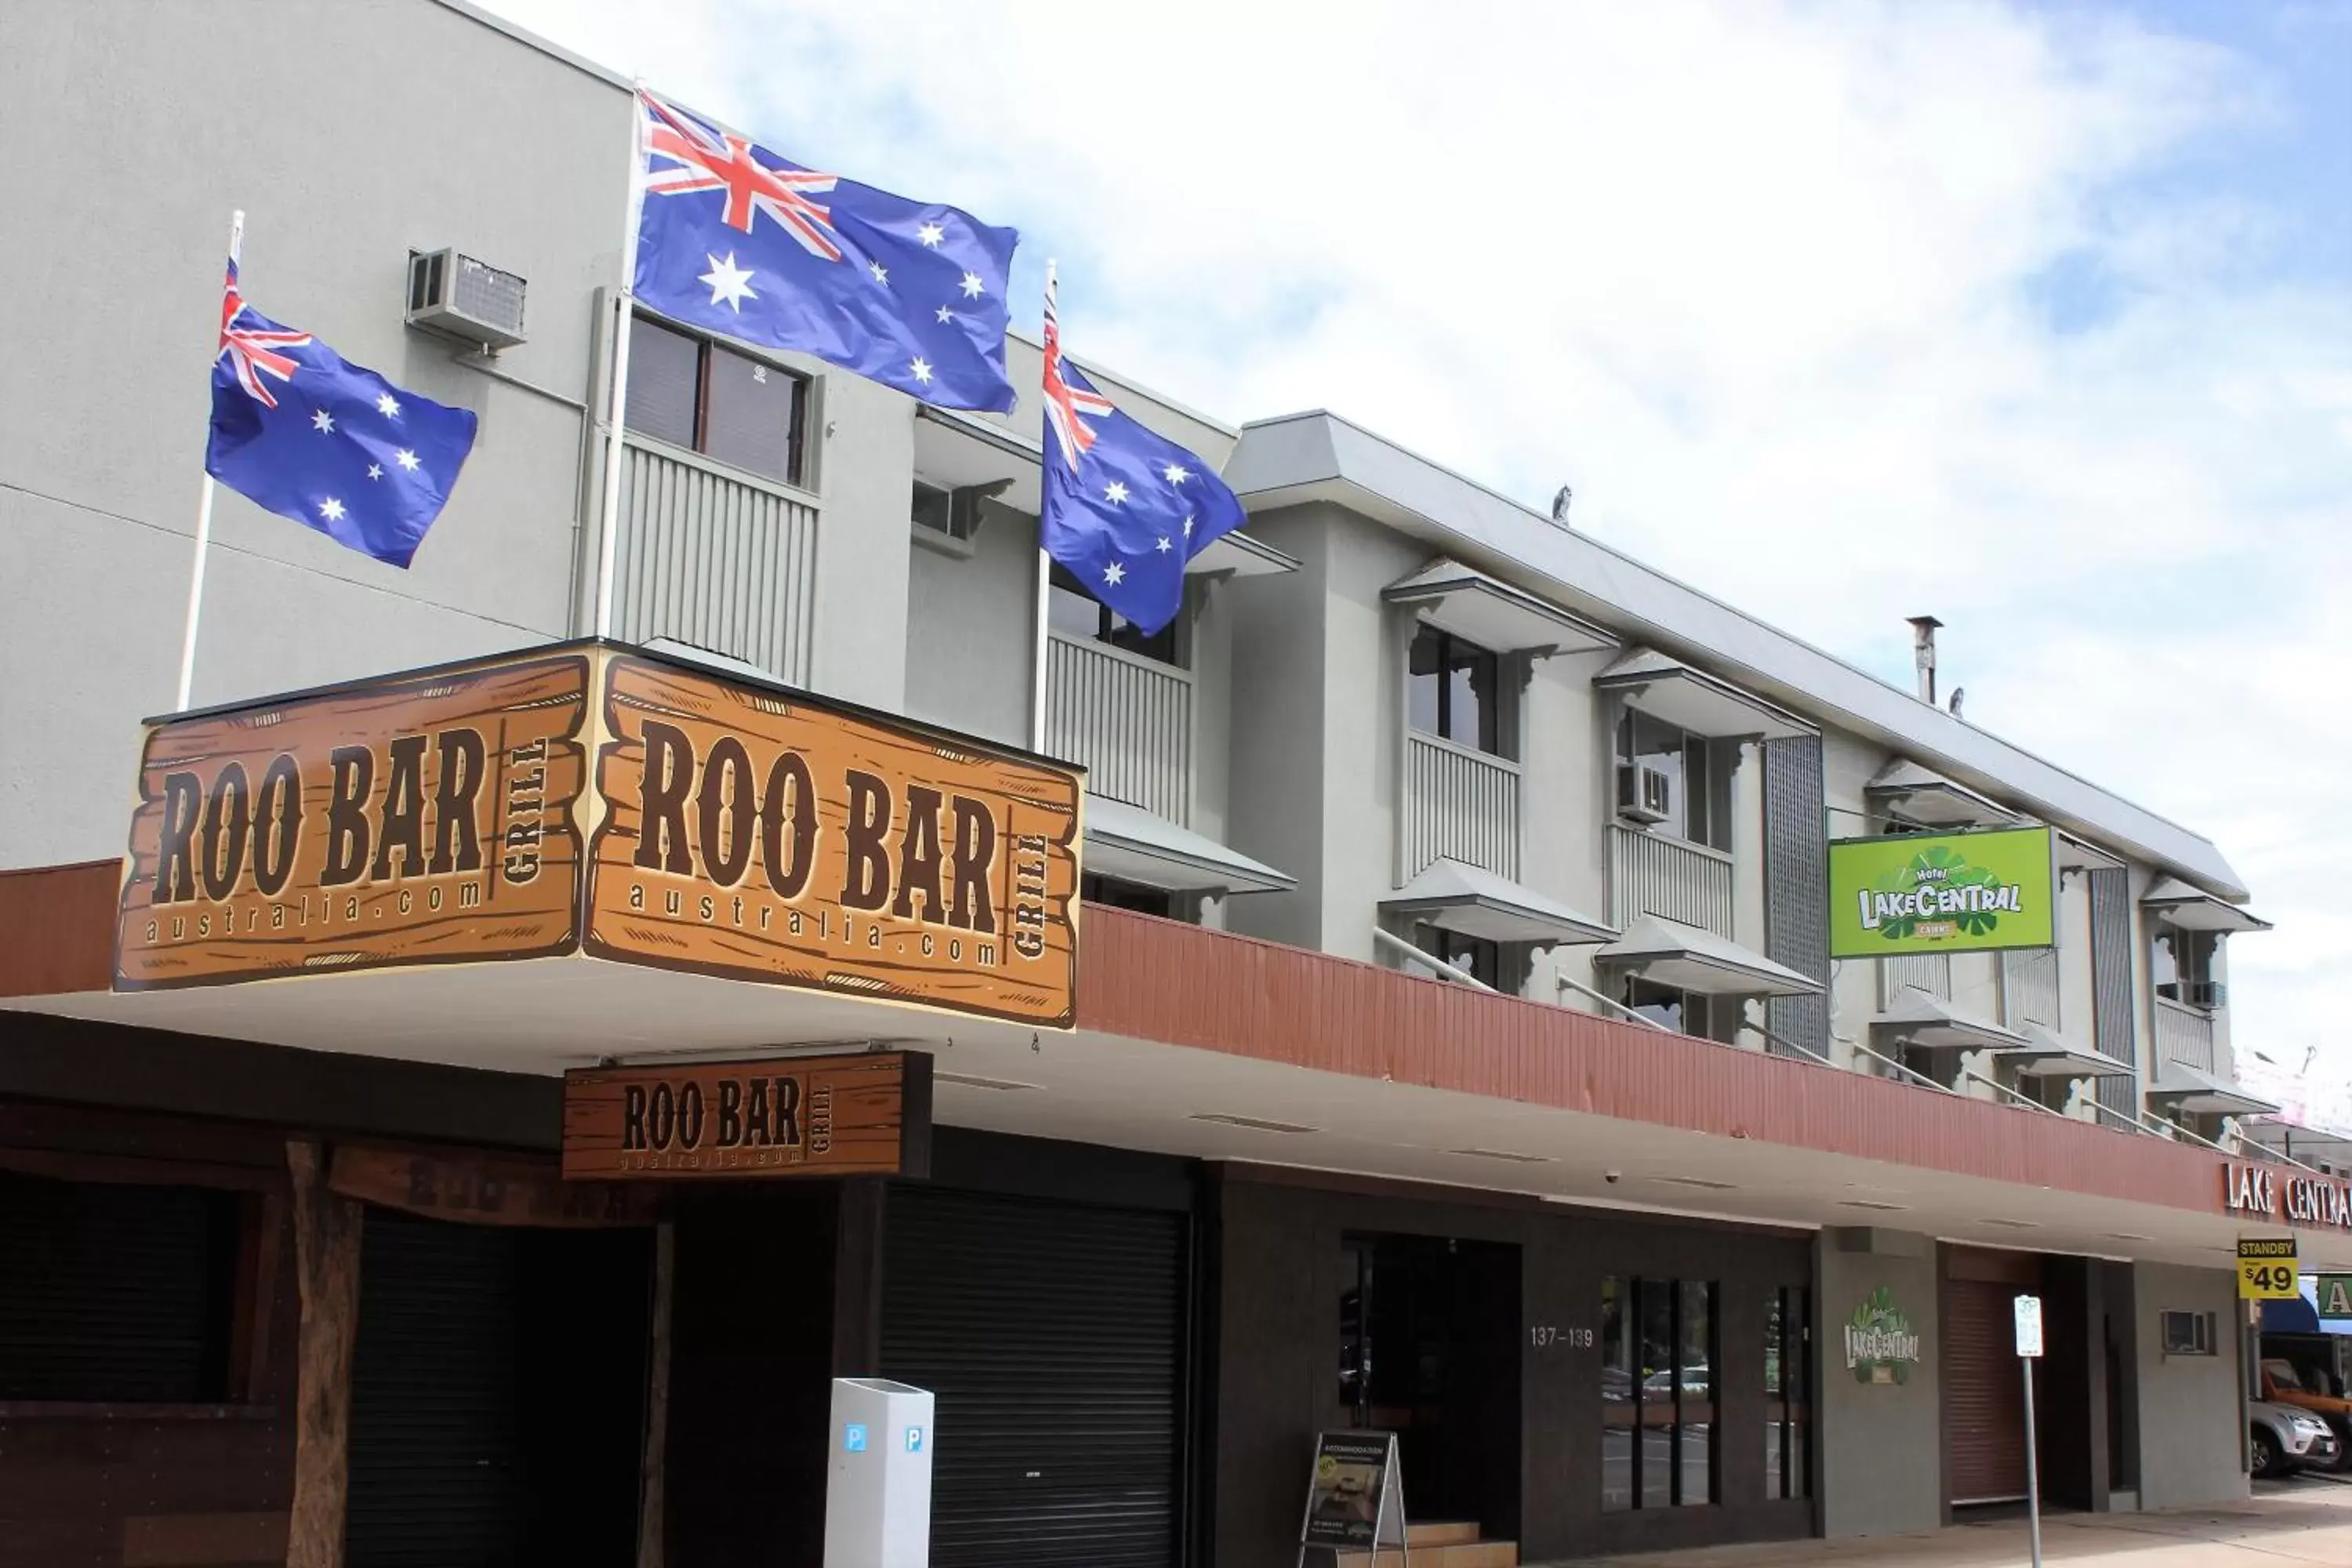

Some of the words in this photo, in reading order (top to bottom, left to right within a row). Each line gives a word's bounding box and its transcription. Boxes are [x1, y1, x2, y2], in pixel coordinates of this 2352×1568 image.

[152, 753, 303, 904] ROO
[320, 728, 485, 887] BAR
[503, 736, 549, 884] GRILL
[634, 720, 821, 898] ROO
[840, 768, 996, 935] BAR
[147, 881, 480, 941] australia.com
[630, 880, 995, 966] australia.com
[1014, 834, 1047, 960] GRILL
[623, 1081, 703, 1152] ROO
[717, 1076, 800, 1148] BAR
[811, 1086, 832, 1153] GRILL
[2225, 1163, 2274, 1213] LAKE
[2240, 1243, 2294, 1254] STANDBY
[2245, 1266, 2292, 1291] $49
[1530, 1326, 1593, 1347] 137-139
